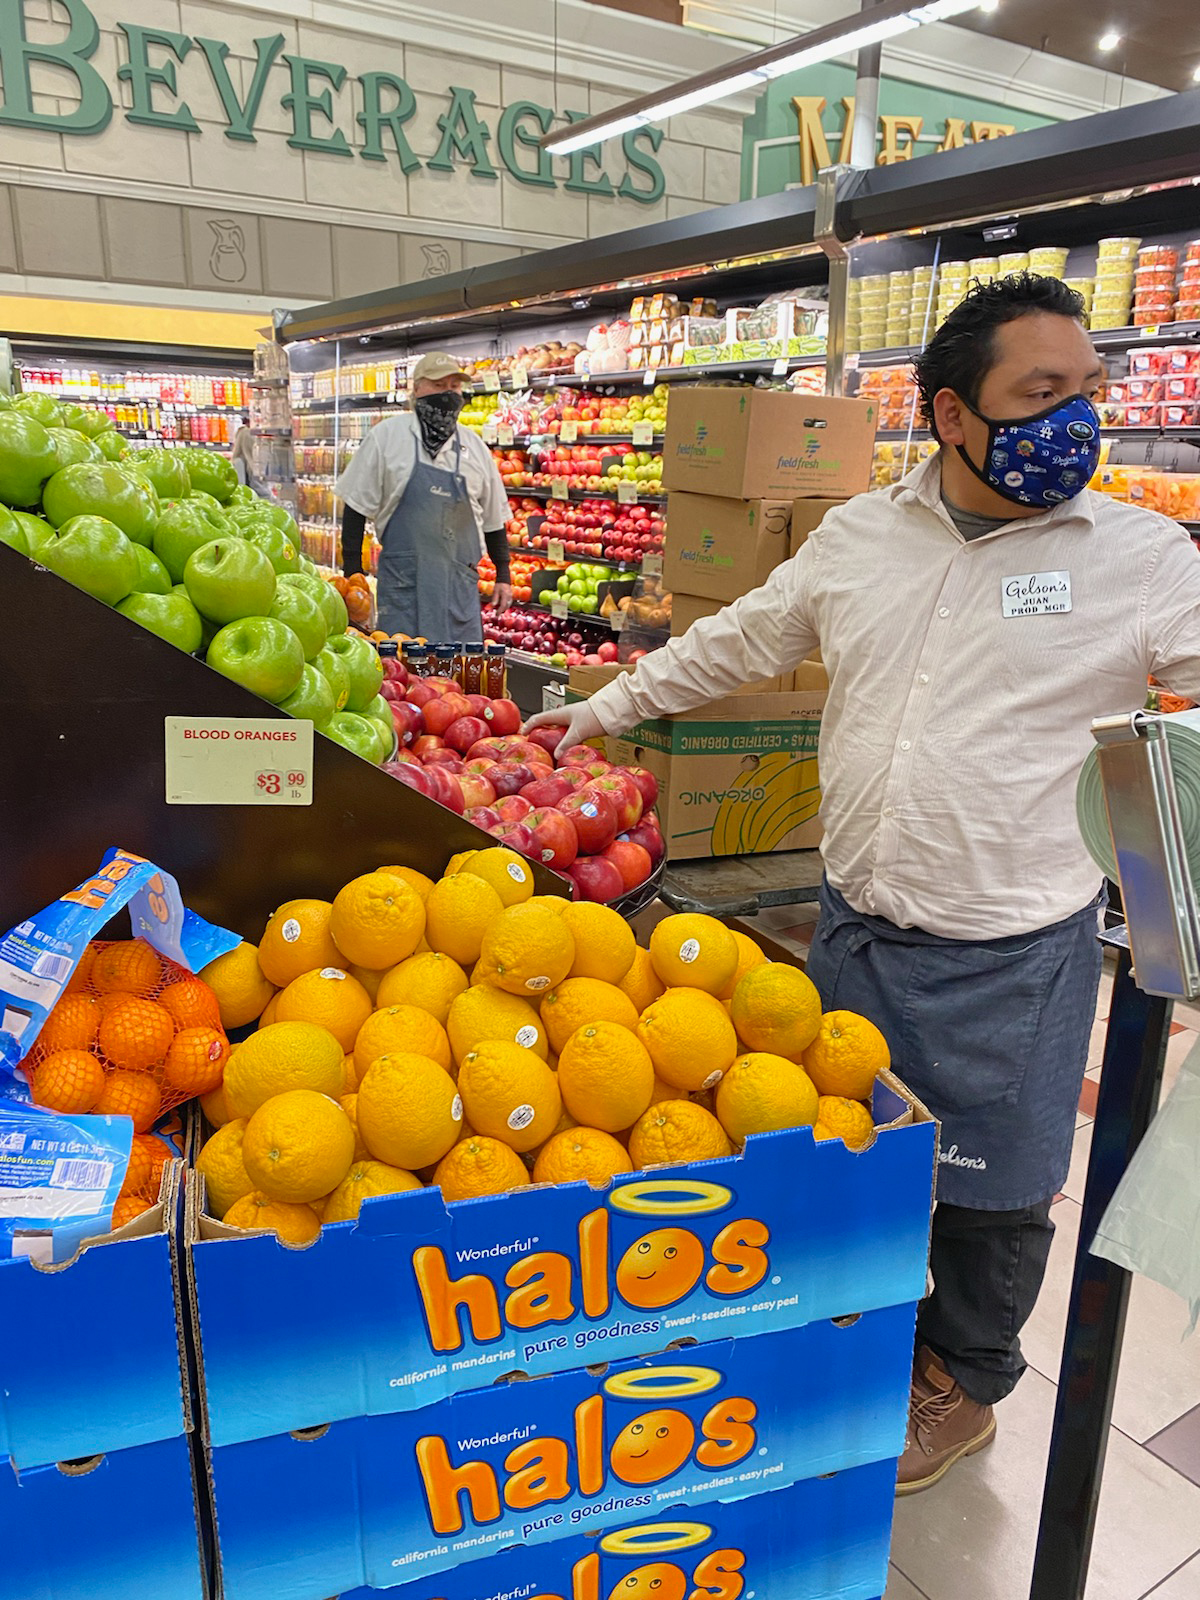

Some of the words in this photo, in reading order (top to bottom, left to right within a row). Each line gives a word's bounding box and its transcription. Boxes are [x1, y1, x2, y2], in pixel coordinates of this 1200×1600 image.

[0, 0, 666, 204] BEVERAGES
[1005, 575, 1067, 599] Gelson's
[1011, 606, 1038, 615] PROD
[1044, 603, 1066, 612] MGR
[1022, 597, 1049, 606] JUAN
[184, 729, 230, 740] BLOOD
[234, 730, 297, 742] ORANGES
[681, 735, 730, 750] ORGANIC
[732, 734, 782, 748] CERTIFIED
[291, 790, 301, 798] lb
[679, 787, 765, 806] ORGANIC
[31, 1139, 46, 1150] NET
[47, 1140, 59, 1152] WT
[938, 1144, 987, 1170] elson's
[456, 1237, 531, 1263] Wonderful
[412, 1207, 771, 1352] halos
[389, 1363, 447, 1387] california
[452, 1349, 516, 1371] mandarins
[523, 1335, 568, 1362] pure
[574, 1319, 661, 1348] goodness
[752, 1299, 776, 1313] easy
[777, 1294, 799, 1310] peel
[457, 1426, 530, 1452] Wonderful
[416, 1394, 758, 1535] halos
[391, 1545, 448, 1567] california
[452, 1529, 515, 1551] mandarins
[521, 1513, 563, 1539] pure
[570, 1492, 652, 1523] goodness
[763, 1462, 784, 1478] peel
